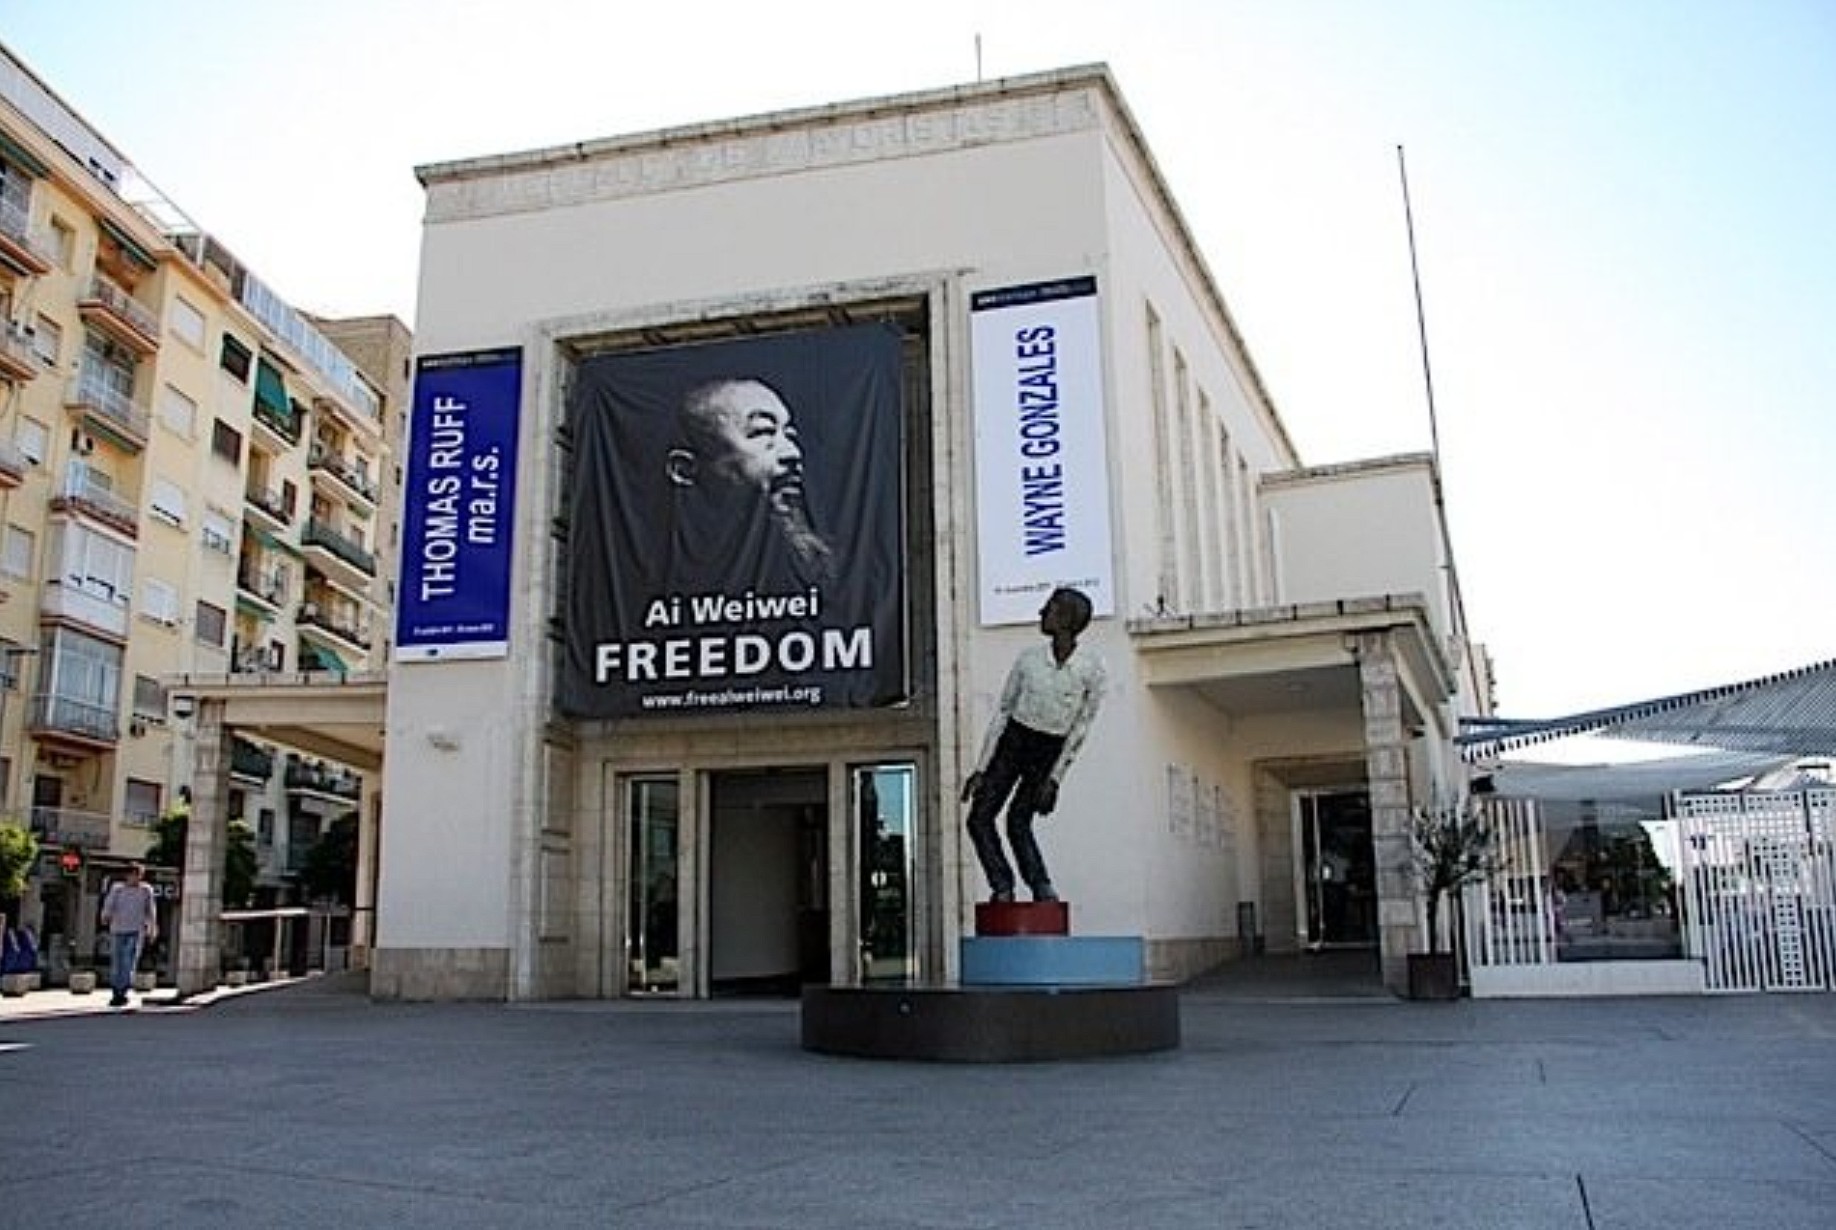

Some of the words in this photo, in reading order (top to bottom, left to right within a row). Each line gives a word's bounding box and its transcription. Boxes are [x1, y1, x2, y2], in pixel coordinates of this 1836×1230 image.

[429, 397, 466, 469] RUFF
[1016, 326, 1061, 458] GONZALES
[421, 475, 461, 601] THOMAS
[468, 447, 499, 544] ma.r.s.
[1021, 463, 1065, 556] WAYNE
[645, 598, 680, 627] Ai
[691, 587, 818, 623] Weiwei
[596, 627, 872, 682] FREEDOM
